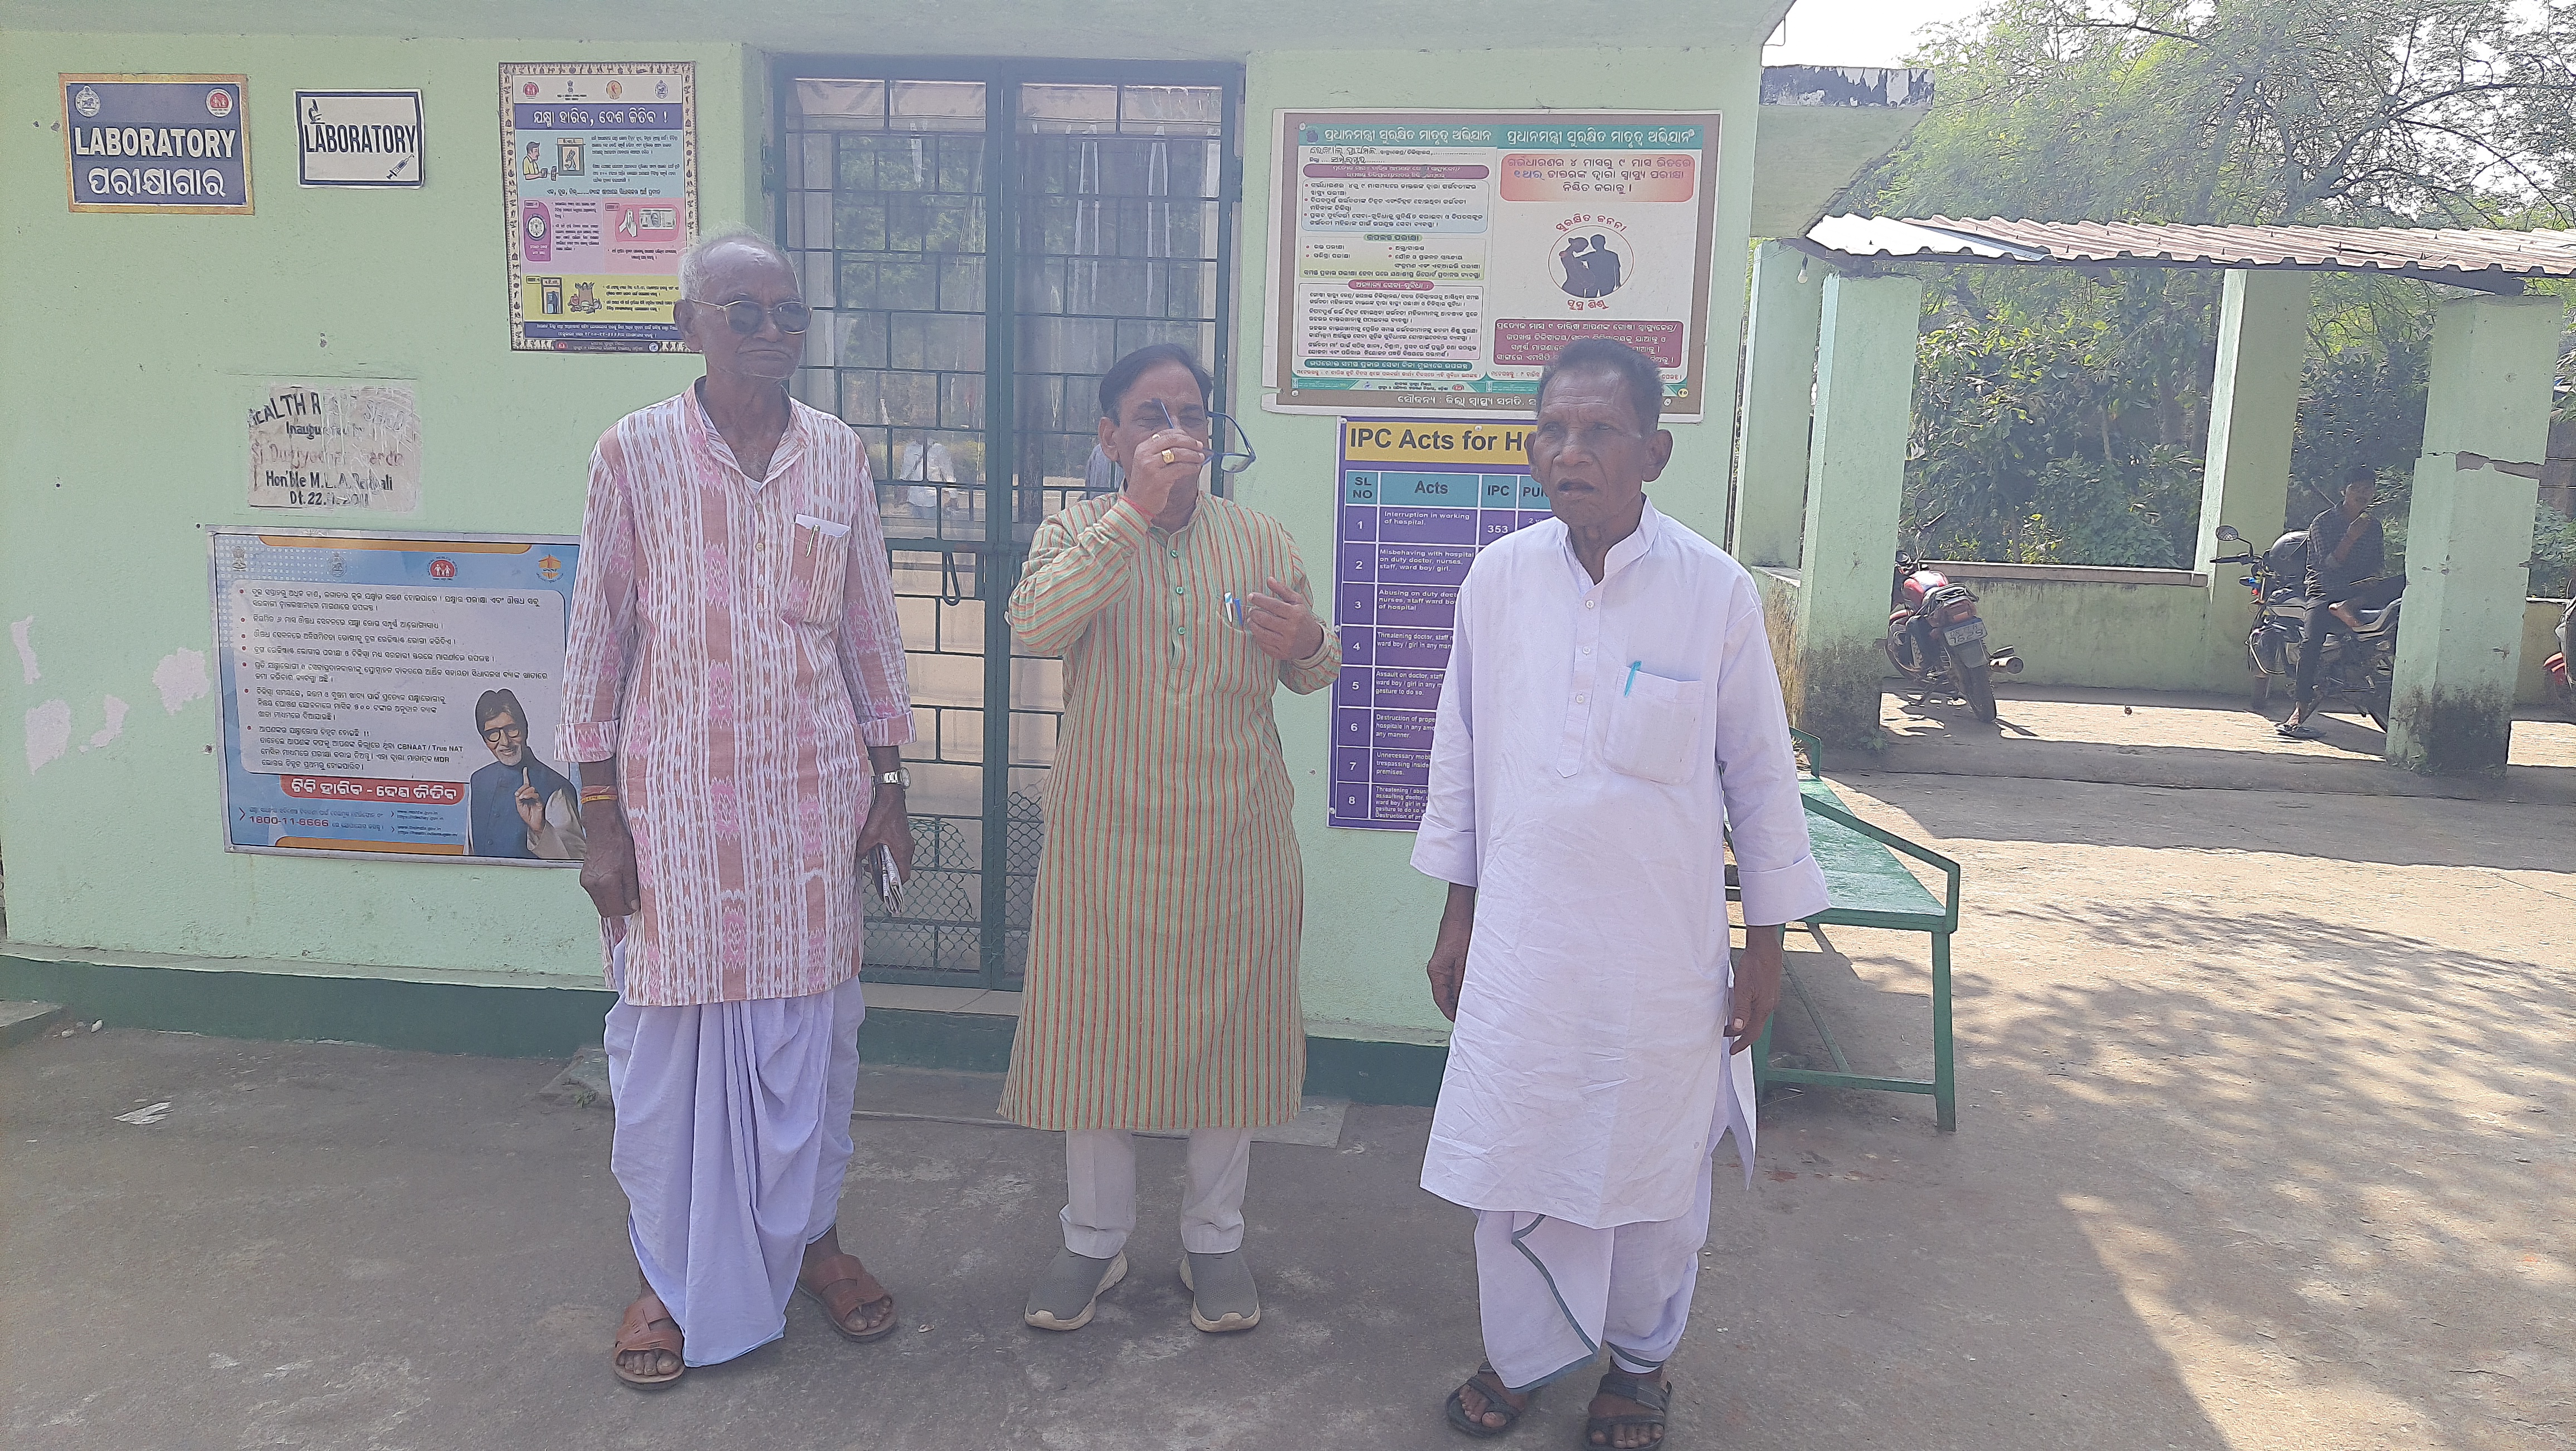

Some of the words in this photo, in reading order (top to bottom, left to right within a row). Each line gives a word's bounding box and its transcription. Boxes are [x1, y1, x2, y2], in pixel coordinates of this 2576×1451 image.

[599, 111, 624, 124] ଦେଶ
[75, 126, 236, 158] LABORATORY
[305, 124, 416, 153] LABORATORY
[87, 168, 226, 197] ପରୀକ୍ଷାଗାର
[1351, 428, 1392, 447] IPC
[1398, 429, 1454, 450] Acts
[1462, 430, 1497, 450] for
[1505, 431, 1526, 451] H
[1355, 477, 1372, 485] SL
[1414, 480, 1448, 494] Acts
[1487, 485, 1509, 496] IPC
[1353, 490, 1373, 498] NO
[1355, 561, 1363, 569] 2
[1353, 642, 1360, 650] 4
[1352, 681, 1359, 690] 5
[1350, 723, 1358, 732] 6
[1350, 762, 1357, 771] 7
[376, 785, 409, 798] ଦେଶ
